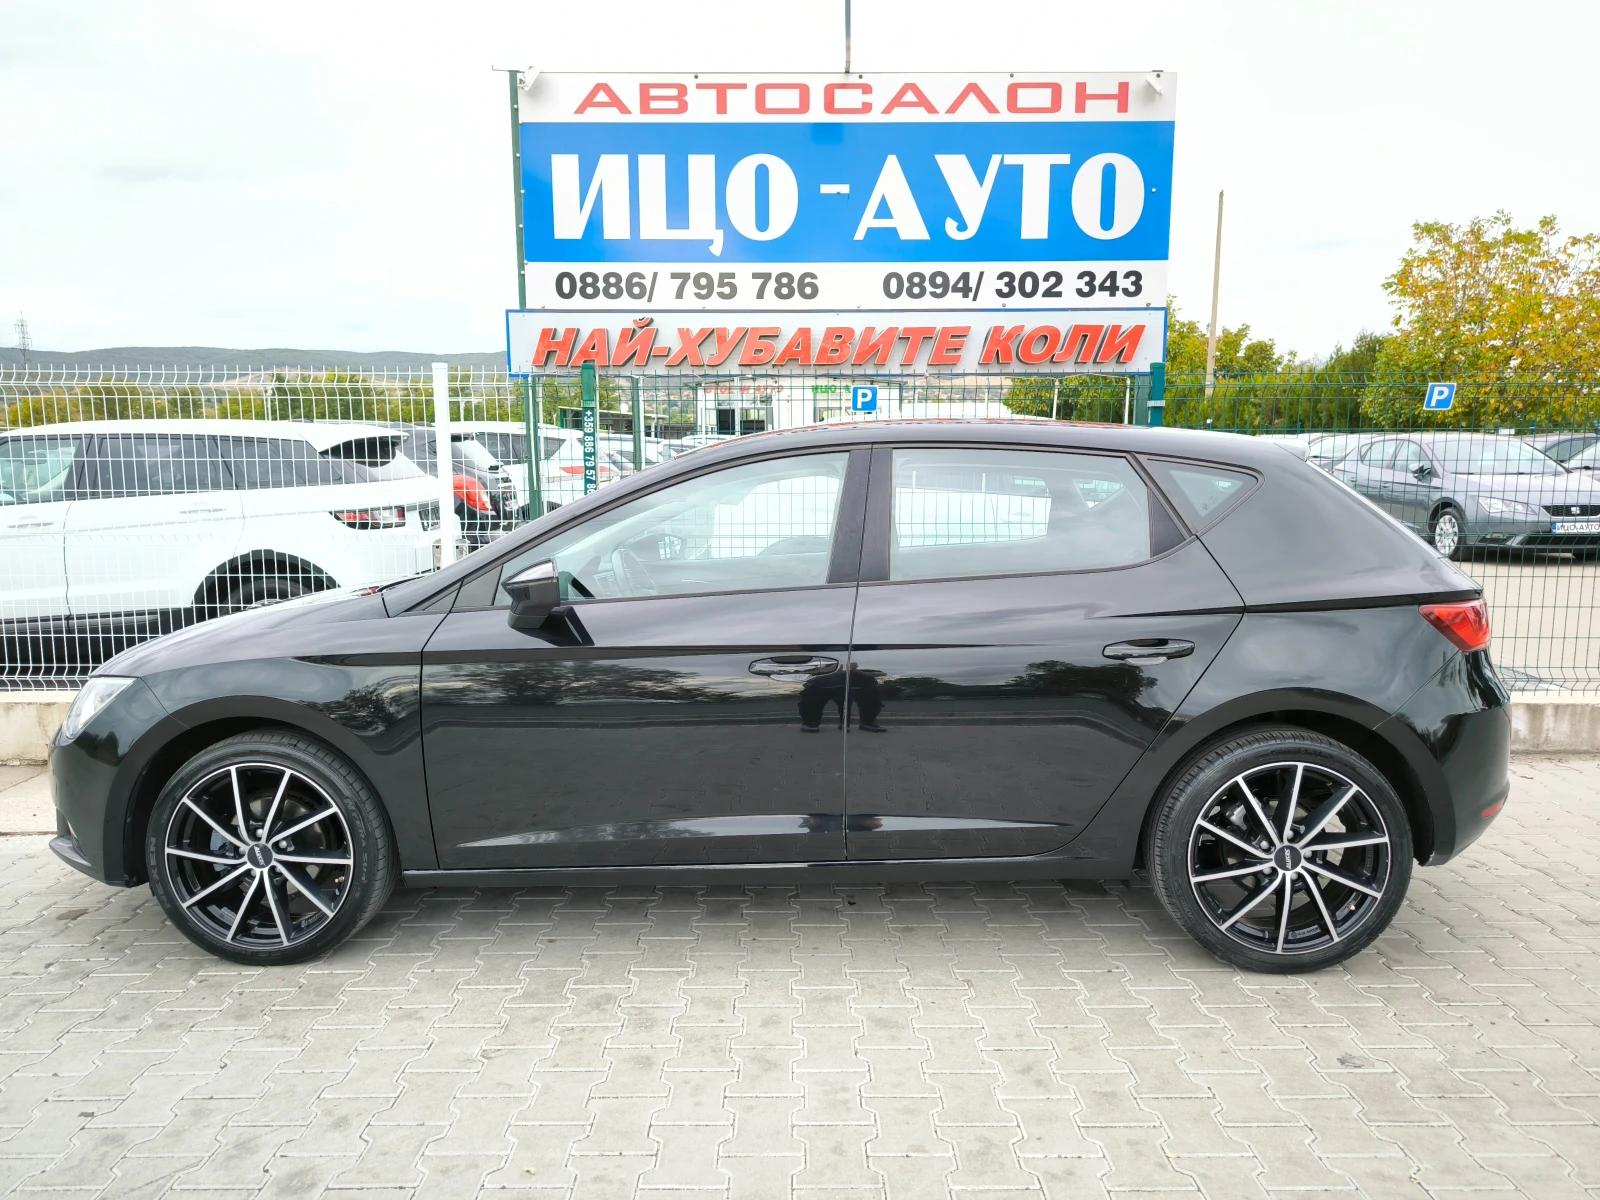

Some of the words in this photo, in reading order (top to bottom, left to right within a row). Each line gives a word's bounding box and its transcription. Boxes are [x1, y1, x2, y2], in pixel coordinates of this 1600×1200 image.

[573, 81, 1130, 115] АВТОСАЛОН
[550, 153, 799, 257] ИЦО
[555, 271, 659, 303] 0886/
[670, 271, 738, 300] 795
[751, 271, 819, 300] 786
[882, 270, 985, 302] 0894/
[995, 270, 1063, 299] 302
[1075, 270, 1143, 298] 343
[531, 317, 971, 367] НАЙ-ХУБАВИТЕ
[979, 324, 1146, 364] КОЛИ
[583, 409, 594, 433] +359
[584, 436, 594, 453] 886
[585, 456, 595, 467] 79
[585, 470, 596, 481] 57
